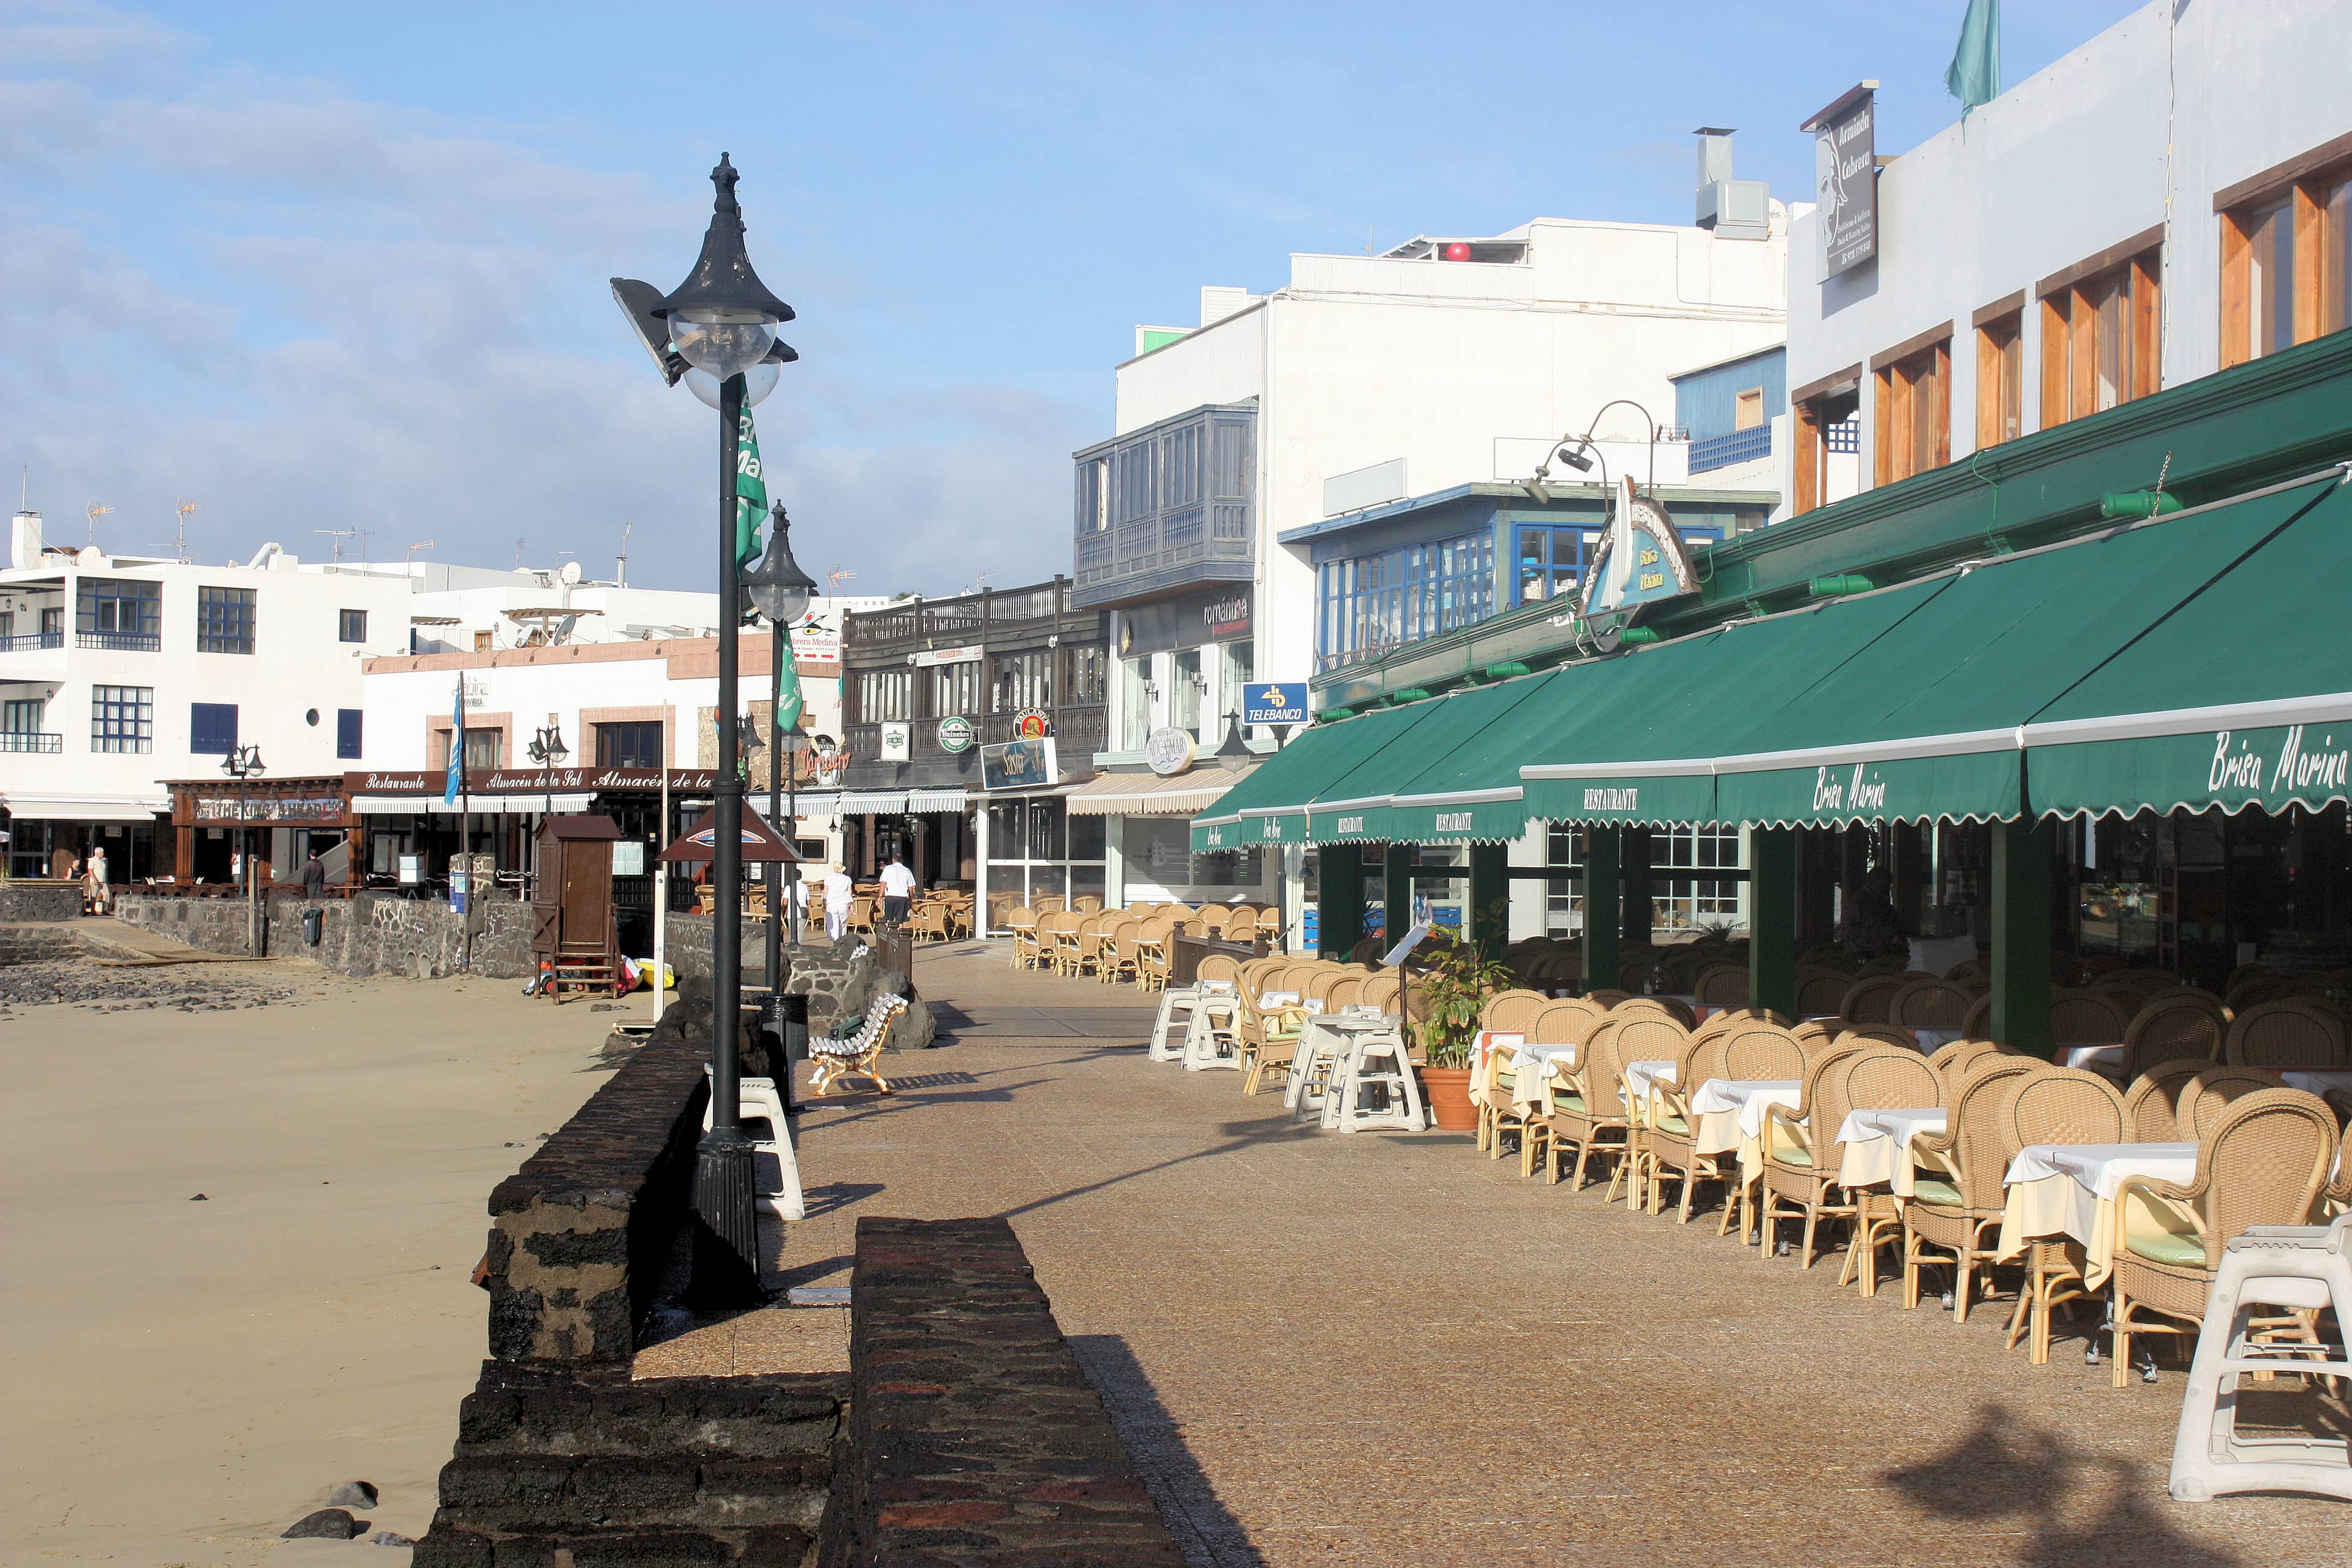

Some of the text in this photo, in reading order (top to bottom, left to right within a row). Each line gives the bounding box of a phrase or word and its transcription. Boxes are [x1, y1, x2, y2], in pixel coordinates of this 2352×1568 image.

[1839, 111, 1870, 146] Arminda
[1842, 151, 1870, 180] Cabrera
[1016, 709, 1049, 725] PAULANER
[1249, 708, 1302, 721] TELEBANCO
[801, 747, 851, 777] Varadero
[1003, 745, 1025, 775] Sasha
[2209, 725, 2348, 794] Brisa Marina
[366, 773, 426, 790] Restaurante
[486, 770, 583, 790] Almacén de la Sal
[592, 771, 714, 789] Almacén de la
[1813, 763, 1886, 813] Brisa Marina
[1583, 788, 1638, 810] RESTAURANTE
[218, 802, 241, 817] THE
[288, 802, 322, 818] HEAD
[1436, 812, 1473, 832] RESTAURANTE
